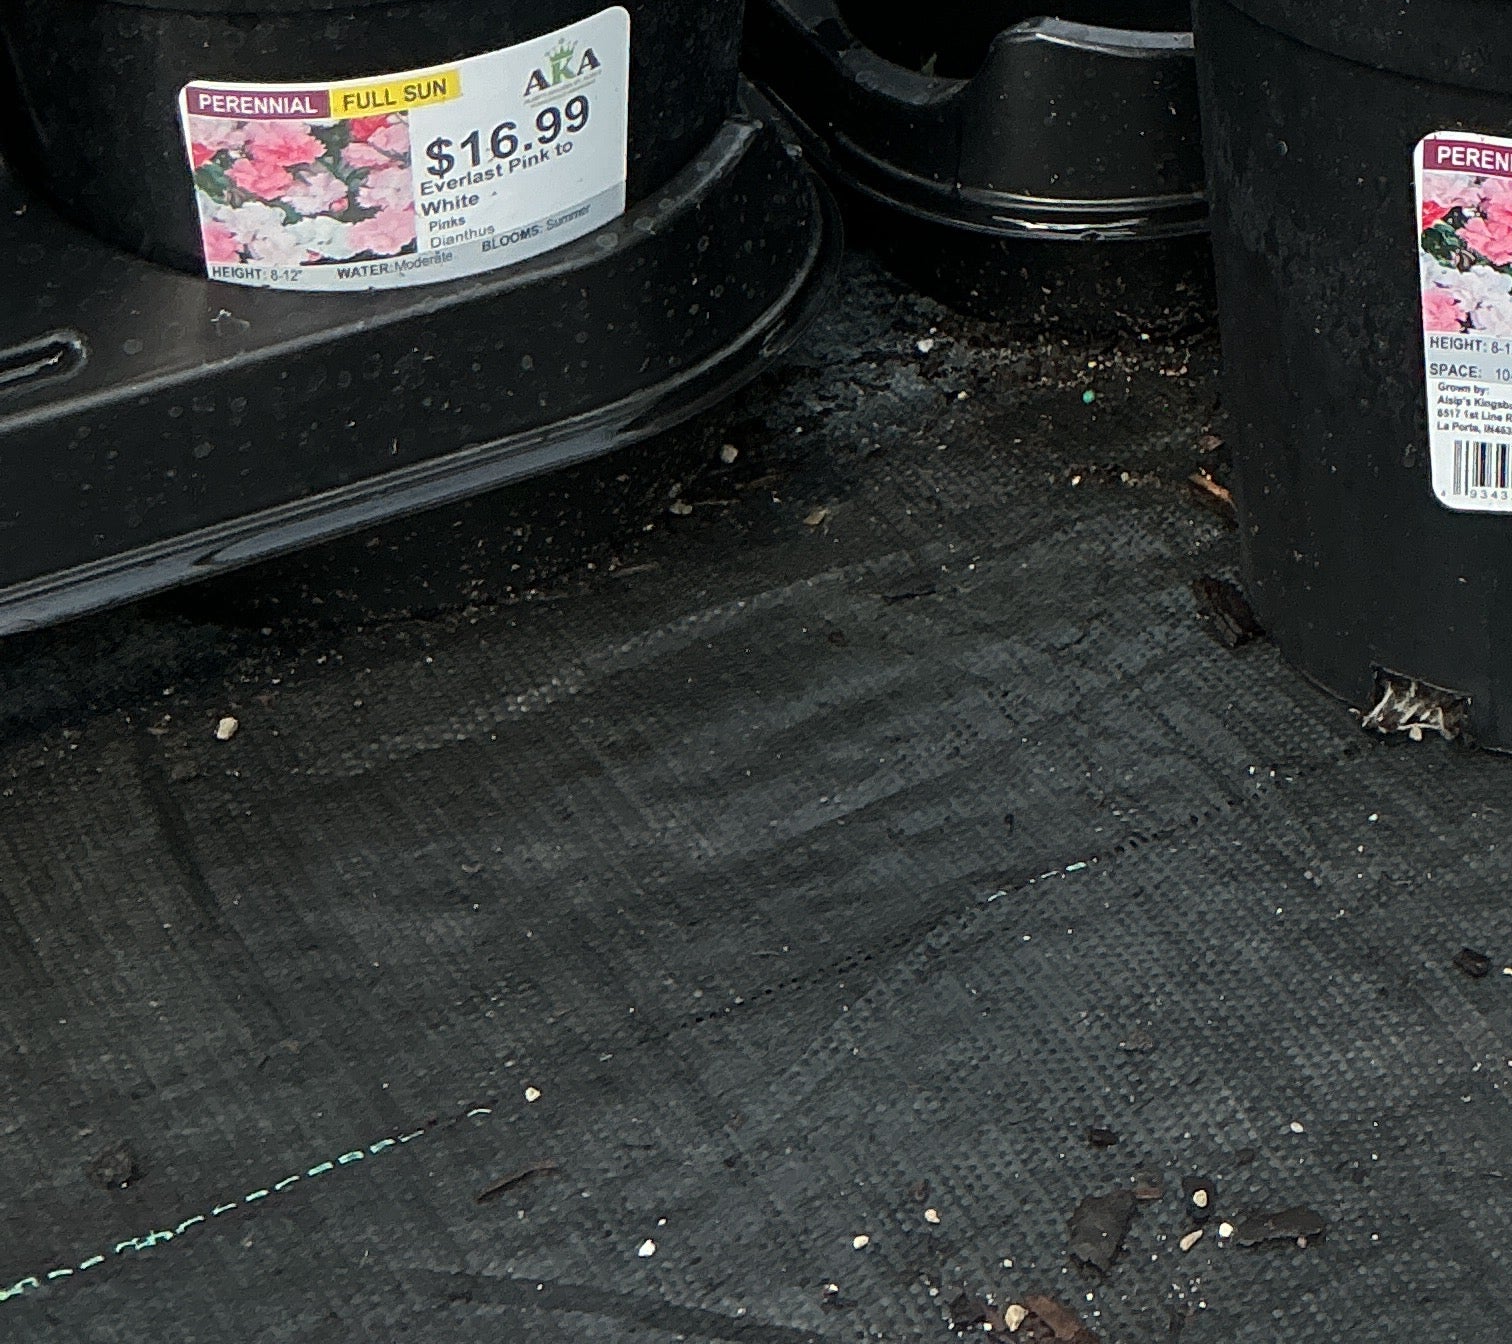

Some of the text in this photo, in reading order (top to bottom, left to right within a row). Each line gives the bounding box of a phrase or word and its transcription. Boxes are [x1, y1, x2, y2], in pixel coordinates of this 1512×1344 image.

[523, 47, 602, 97] AKA
[199, 93, 319, 115] PERENNIAL
[343, 78, 447, 112] FULL SUN
[426, 94, 590, 180] $16.99
[420, 140, 574, 196] Everlast Pink to
[420, 193, 480, 217] White
[429, 215, 466, 232] Pinks
[430, 224, 496, 250] Dianthus
[212, 265, 267, 281] HEIGHT:
[481, 226, 544, 253] BLOOMS:
[1429, 336, 1488, 354] HEIGHT:
[1429, 362, 1482, 379] SPACE:
[1437, 381, 1490, 397] Grown by:
[1436, 421, 1450, 431] La
